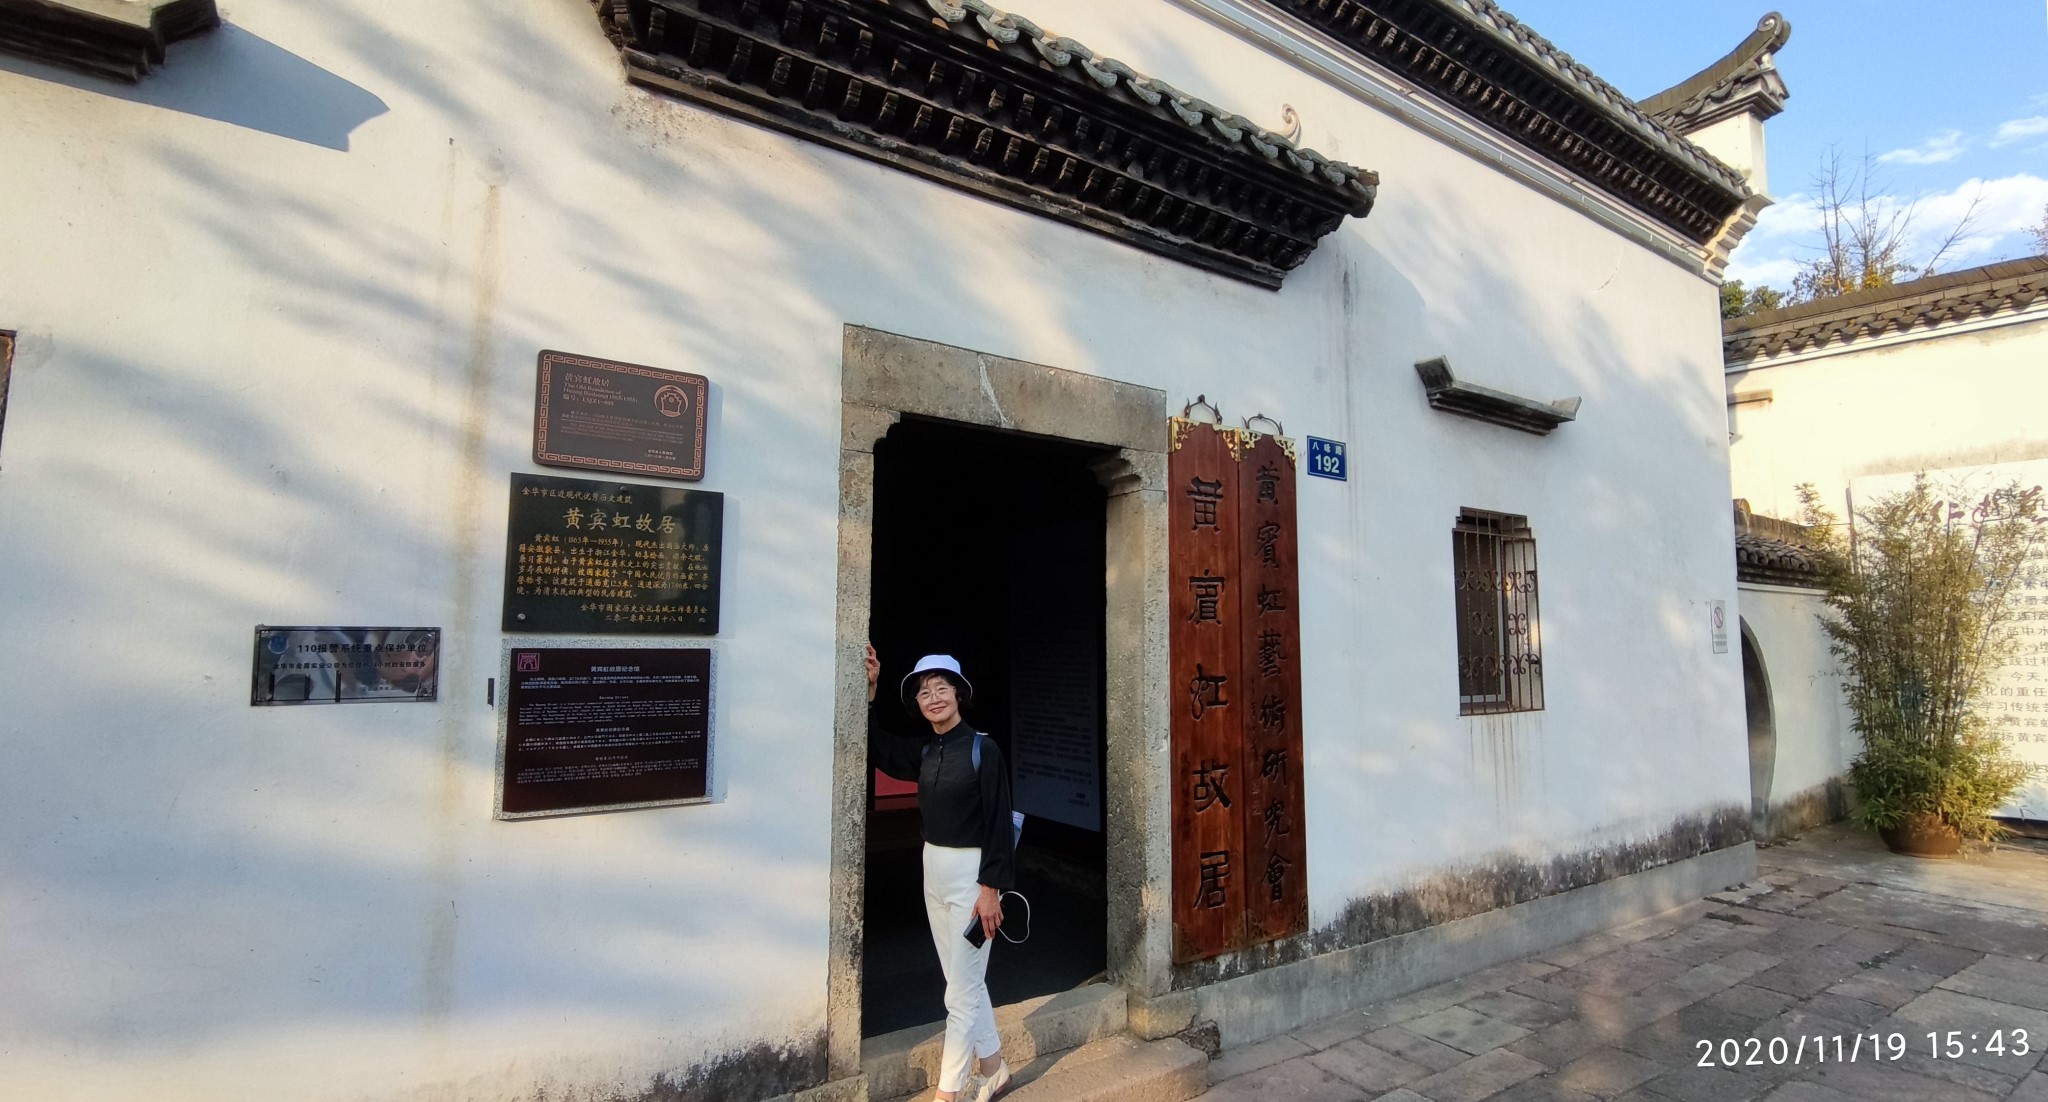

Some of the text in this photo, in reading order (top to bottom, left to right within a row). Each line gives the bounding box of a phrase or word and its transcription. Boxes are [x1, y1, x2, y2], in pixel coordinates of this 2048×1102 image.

[1315, 454, 1340, 474] 192
[562, 507, 676, 534] 黄宾虹故居
